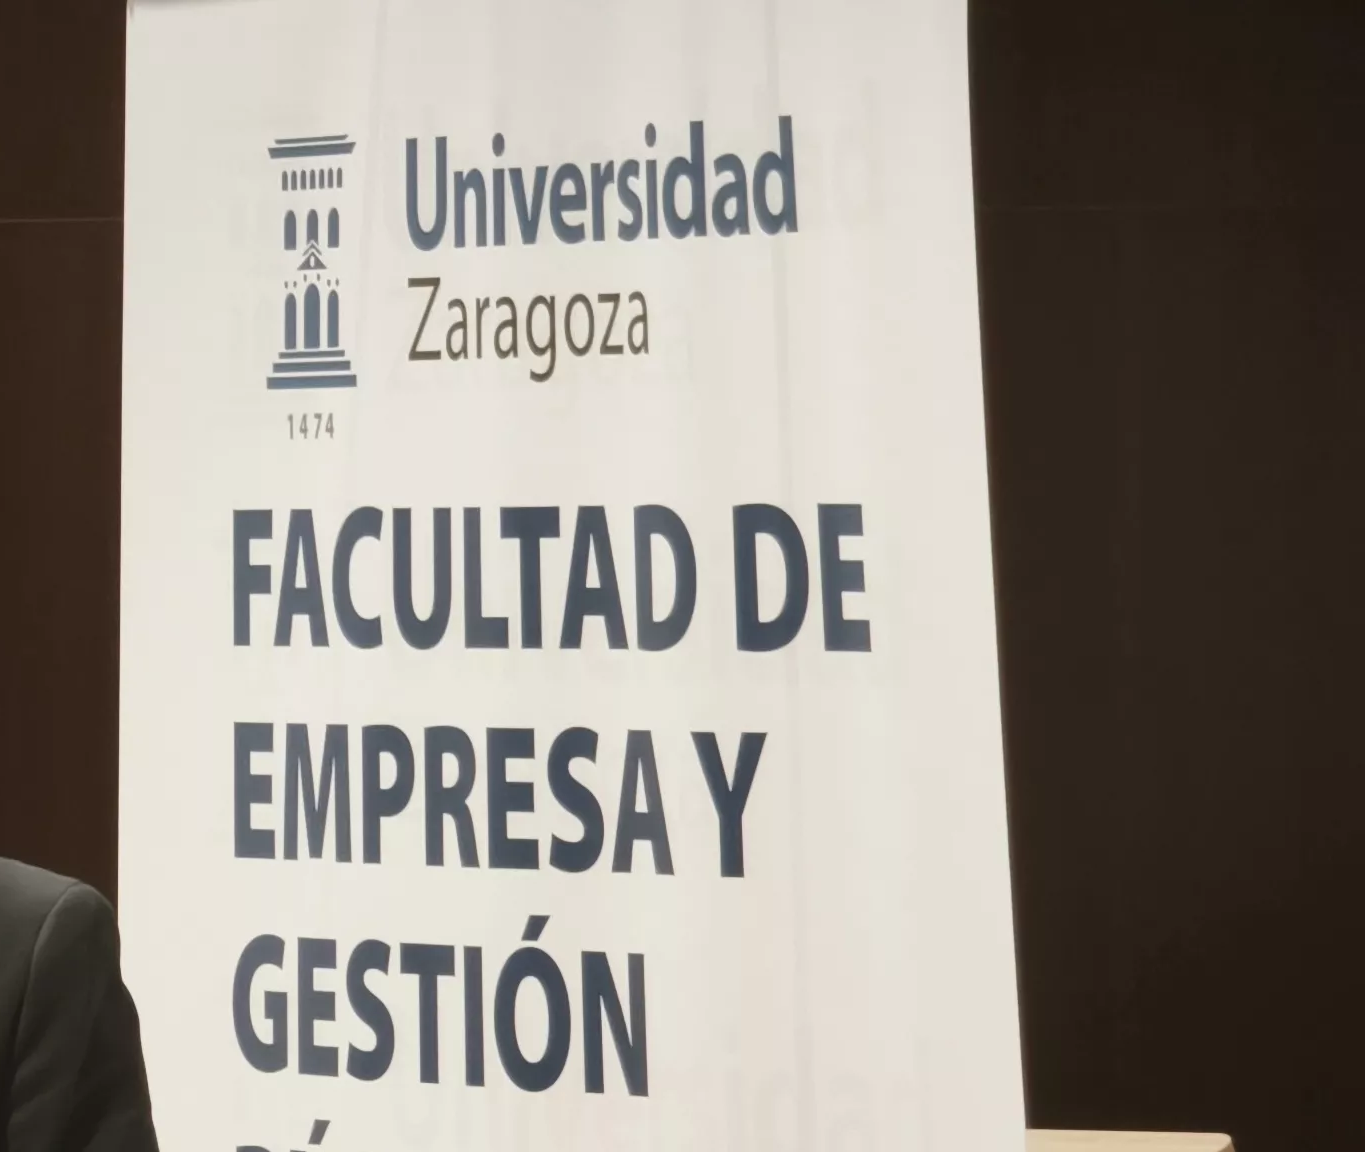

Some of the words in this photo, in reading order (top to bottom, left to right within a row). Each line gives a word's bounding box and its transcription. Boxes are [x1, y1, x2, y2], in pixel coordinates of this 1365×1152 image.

[405, 115, 798, 251] Universidad
[406, 276, 650, 383] Zaragoza
[286, 411, 335, 440] 1474
[232, 503, 698, 652] FACULTAD
[731, 502, 872, 653] DE
[232, 721, 675, 876] EMPRESA
[690, 730, 769, 879] Y
[232, 914, 650, 1098] GESTIÓN
